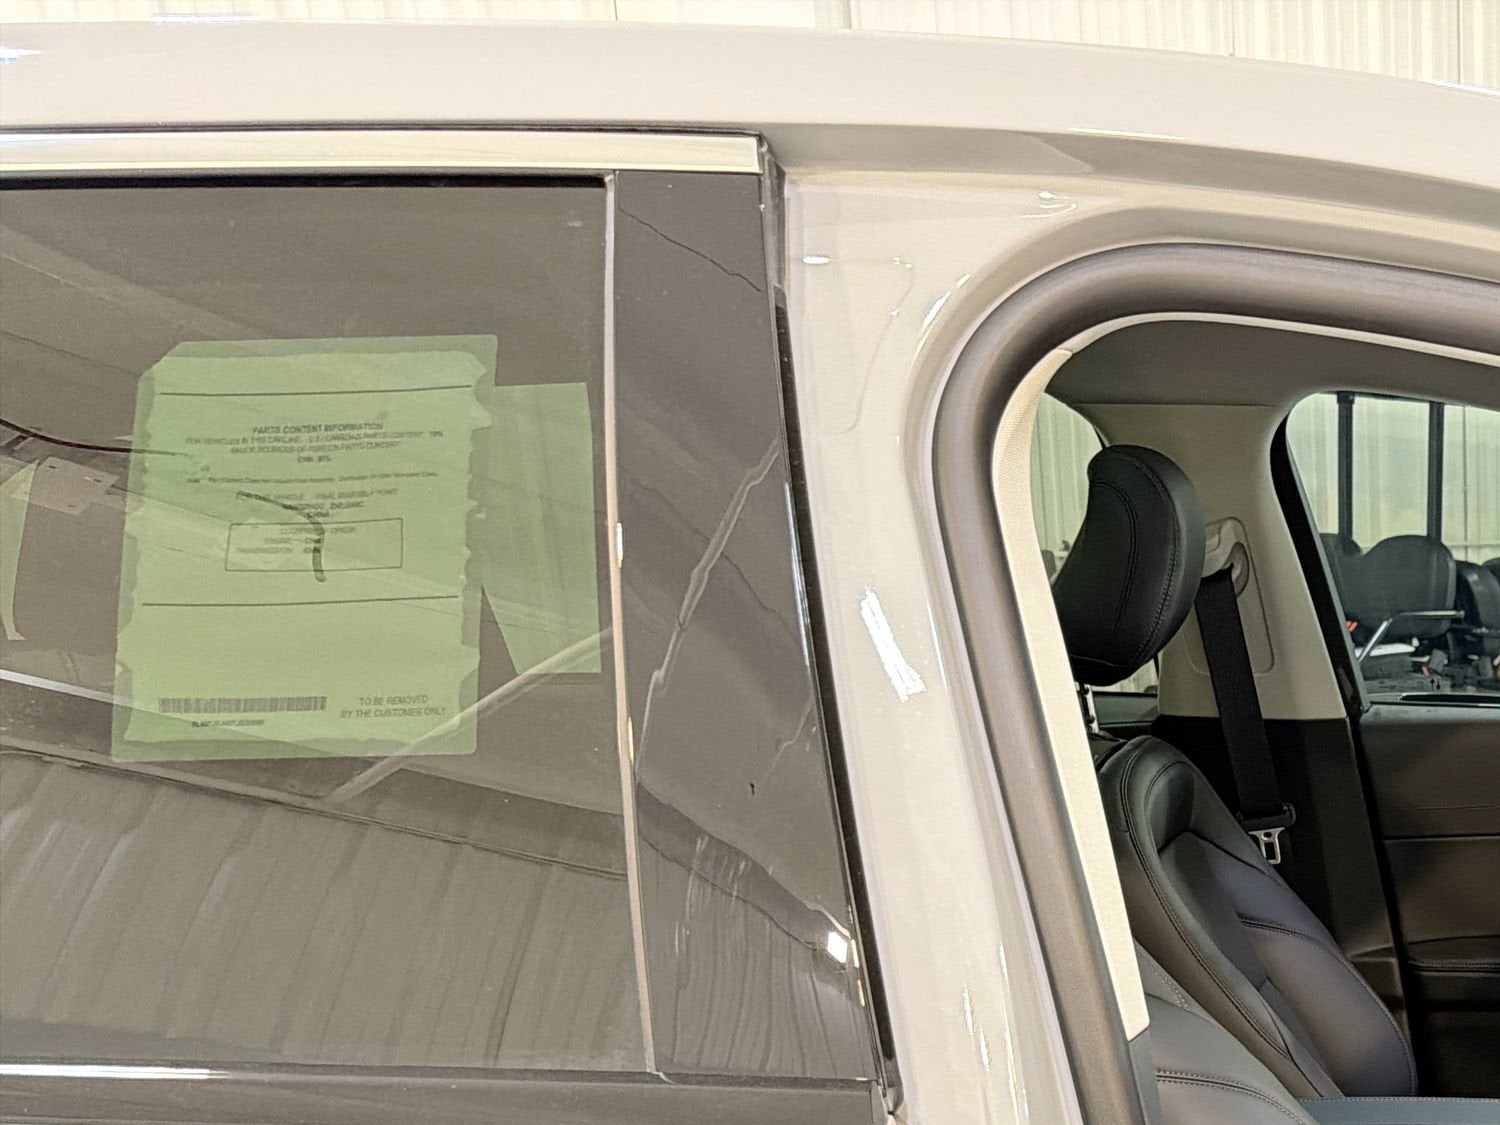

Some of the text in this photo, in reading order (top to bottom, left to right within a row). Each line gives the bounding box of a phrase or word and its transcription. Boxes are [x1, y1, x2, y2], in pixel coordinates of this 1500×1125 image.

[282, 424, 322, 434] CONTENT
[324, 422, 384, 433] INFORMATION
[359, 694, 429, 706] TO BE REMOVED
[340, 706, 448, 719] BY THE CUSTOMER ONLY
